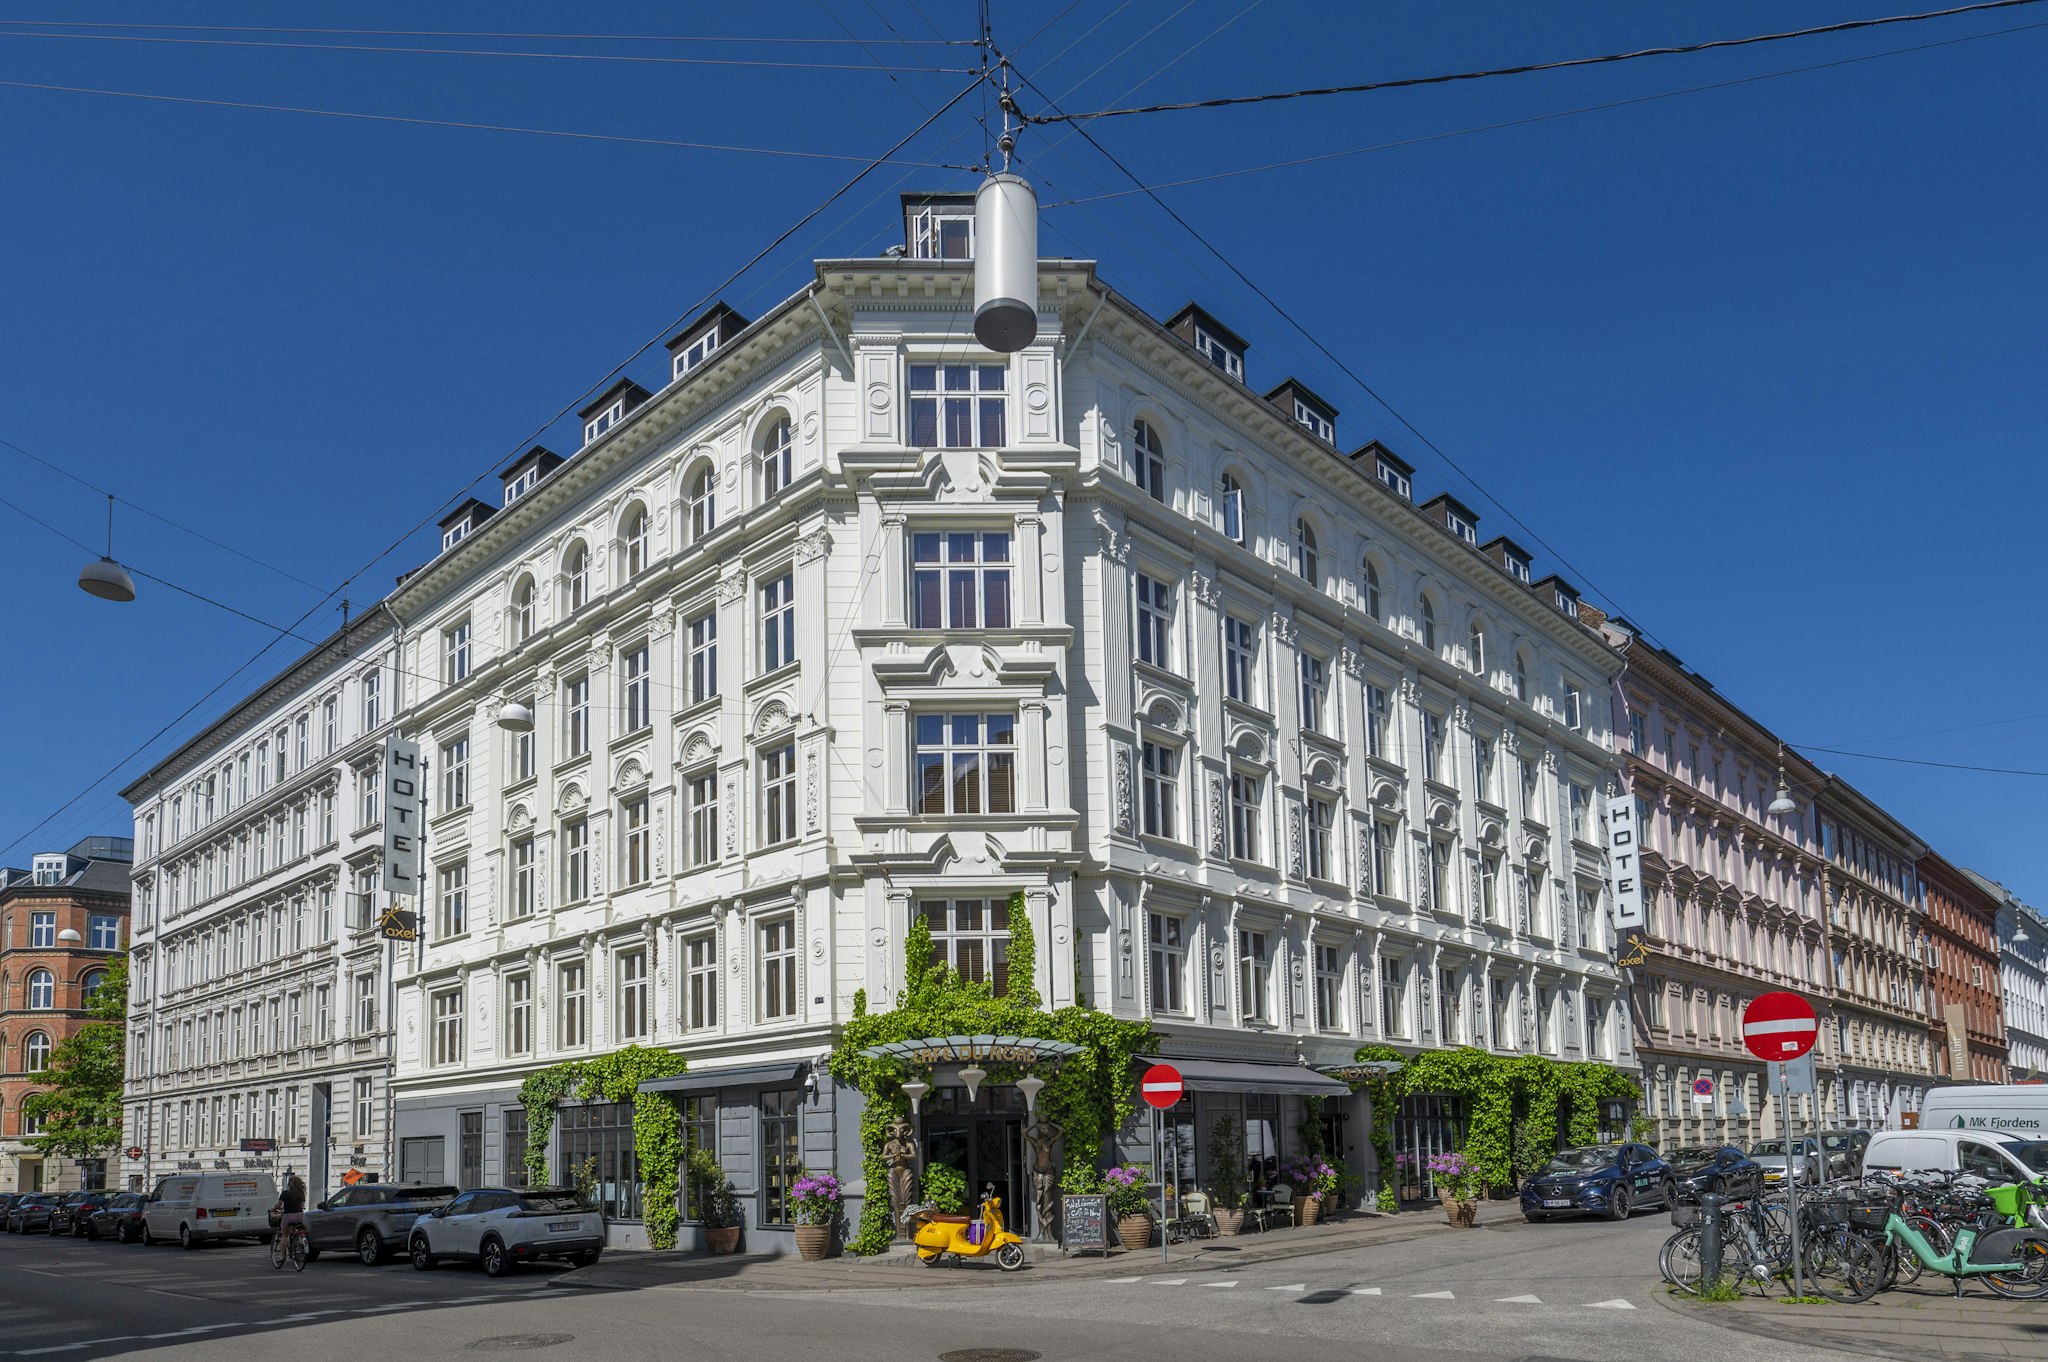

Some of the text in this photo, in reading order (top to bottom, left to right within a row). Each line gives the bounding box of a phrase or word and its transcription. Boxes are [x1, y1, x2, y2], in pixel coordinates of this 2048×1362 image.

[393, 750, 415, 881] HOTEL
[1612, 806, 1636, 918] HOTEL
[385, 927, 415, 940] axel
[1618, 953, 1645, 967] axel
[959, 1045, 984, 1061] DU
[989, 1046, 1038, 1063] NORD
[1969, 1116, 2040, 1129] MK Fjordens
[1957, 1236, 1969, 1252] Bolt
